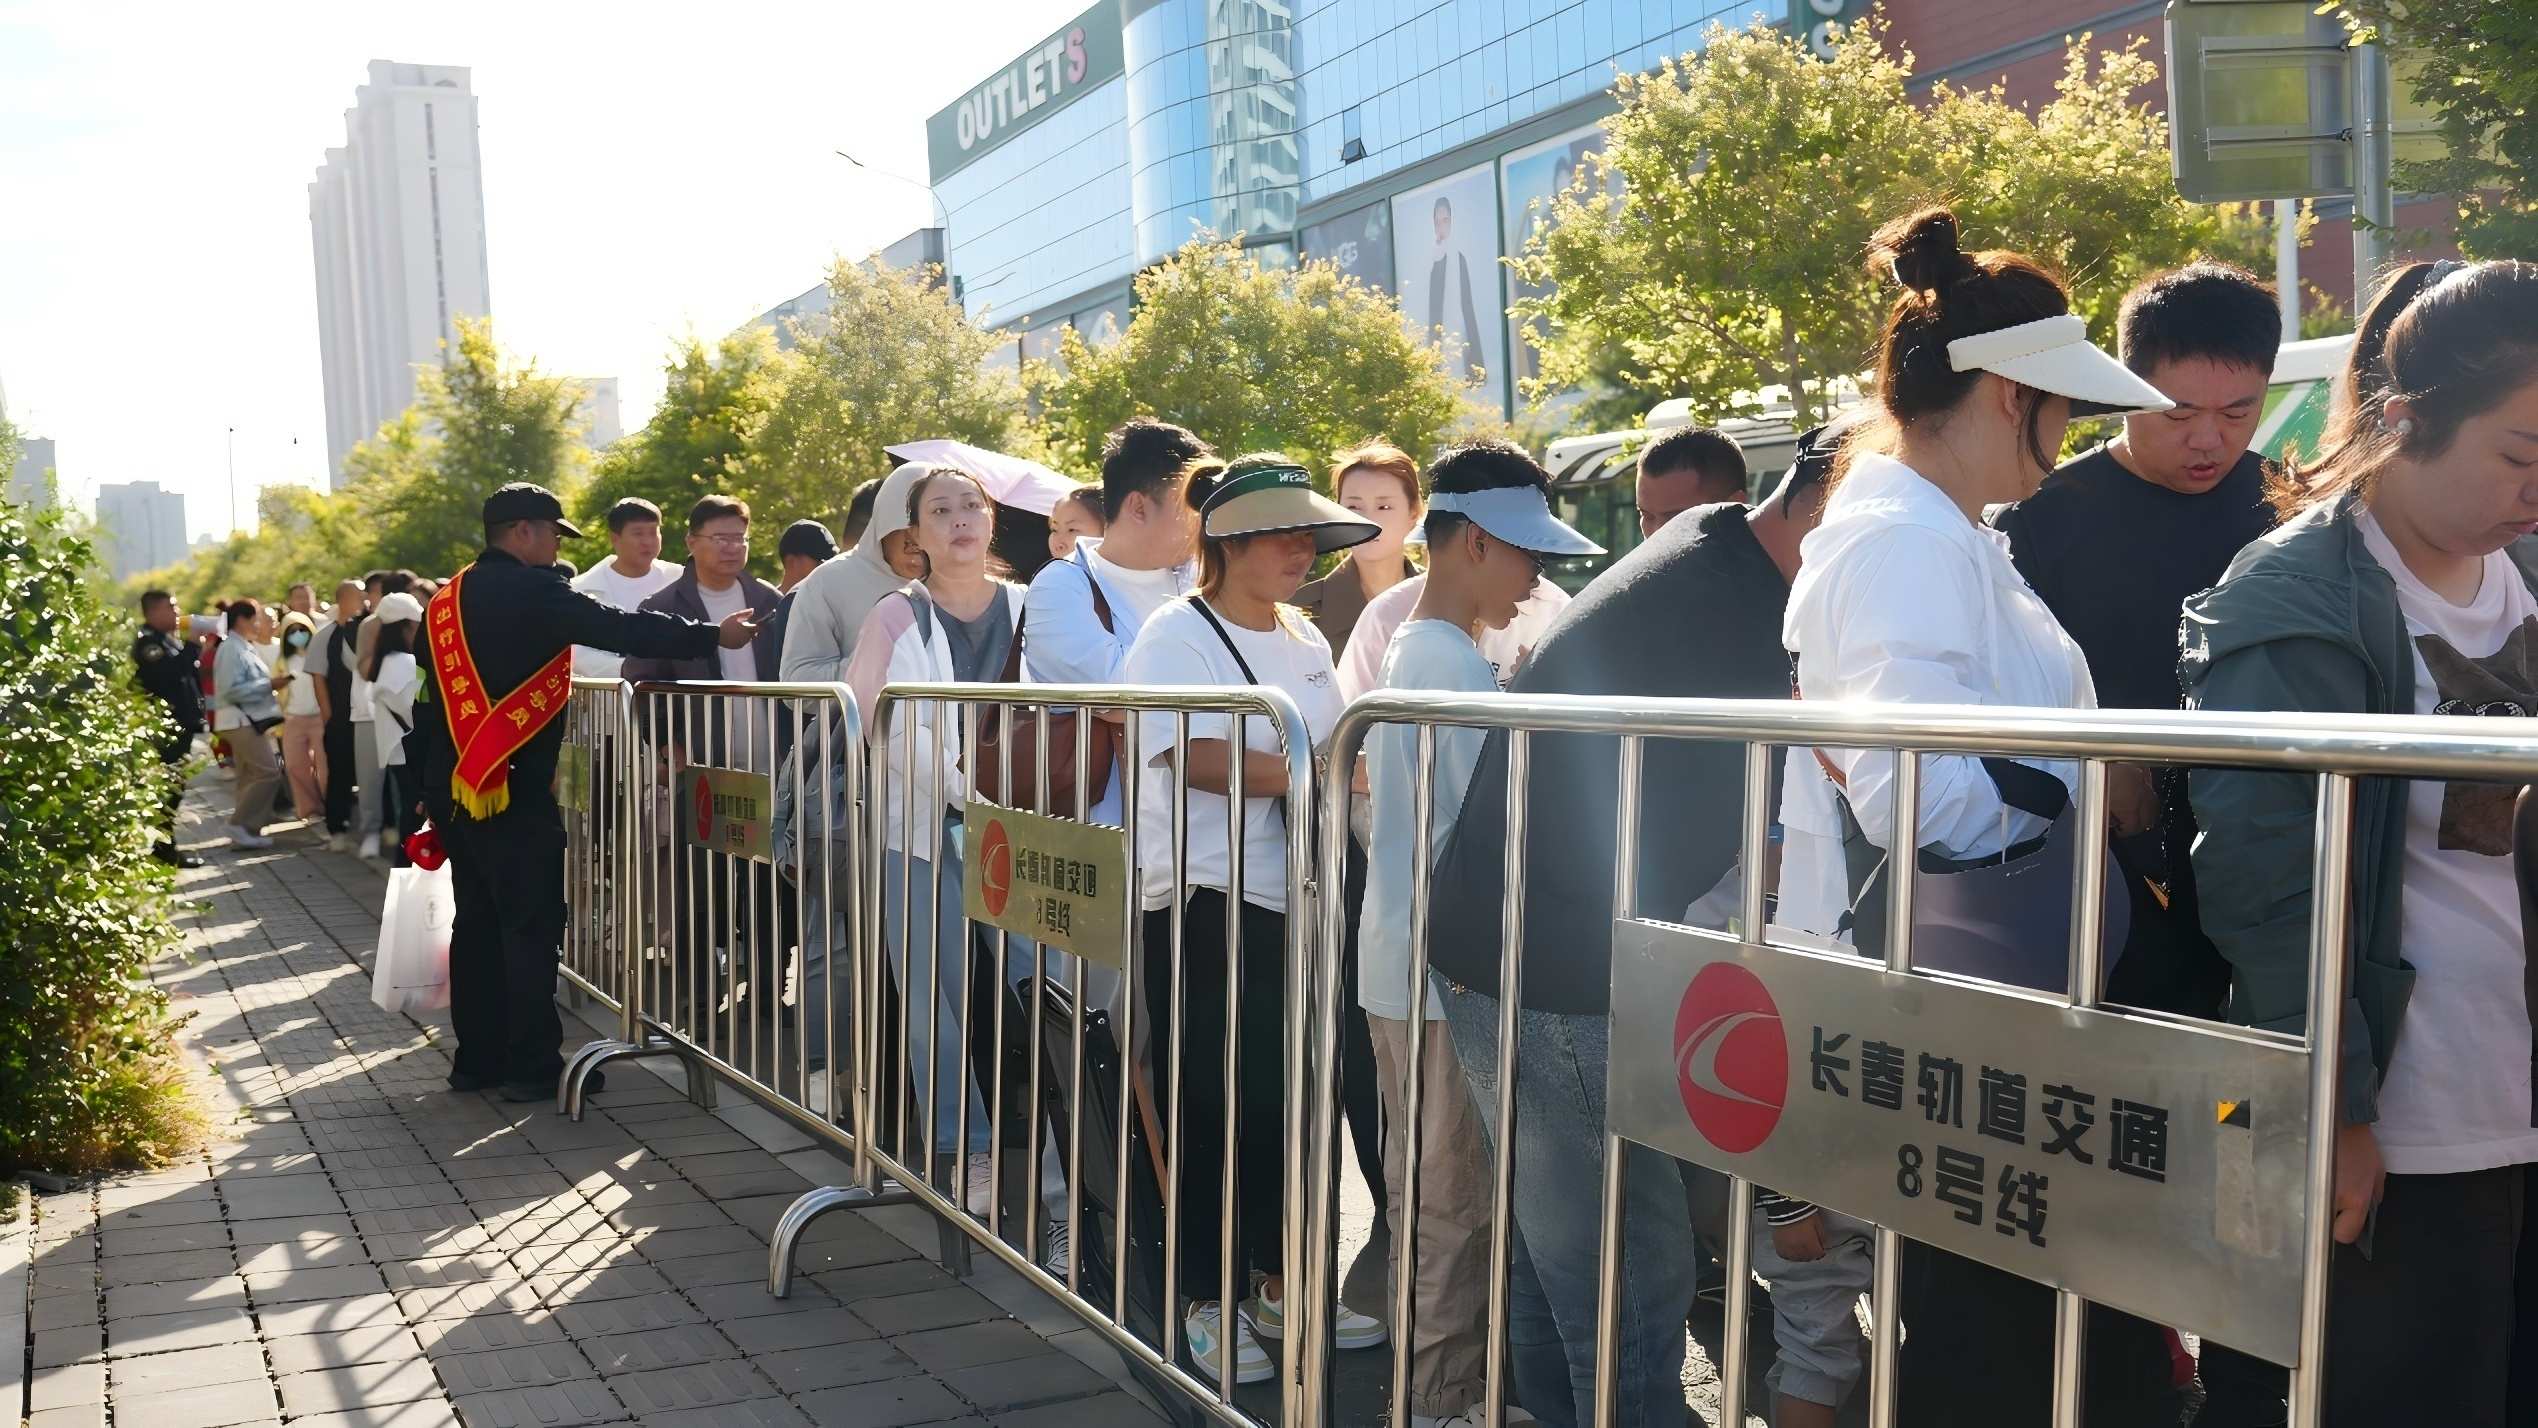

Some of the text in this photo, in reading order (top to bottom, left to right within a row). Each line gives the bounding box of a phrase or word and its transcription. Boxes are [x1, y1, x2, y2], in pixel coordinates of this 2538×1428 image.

[957, 26, 1088, 151] OUTLETS
[1809, 1025, 2169, 1184] 长春轨道交通
[1897, 1143, 2049, 1248] 8号线
